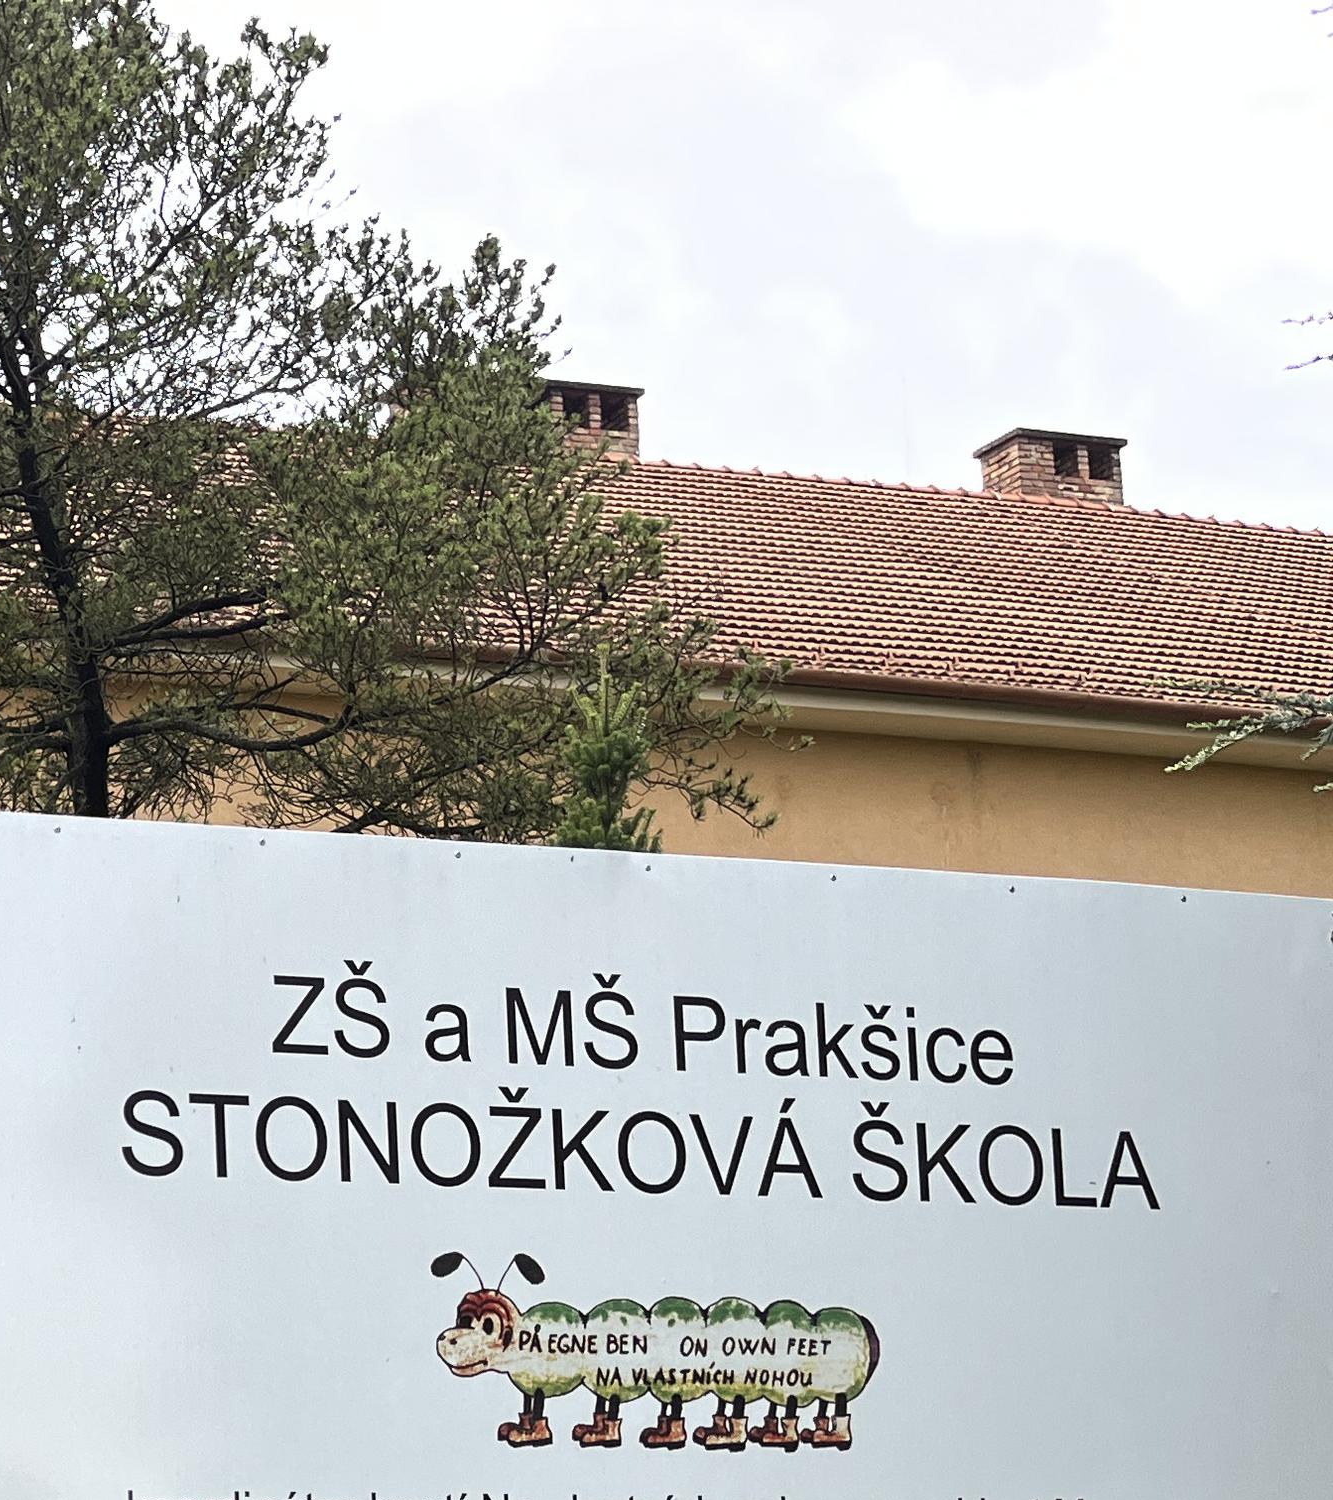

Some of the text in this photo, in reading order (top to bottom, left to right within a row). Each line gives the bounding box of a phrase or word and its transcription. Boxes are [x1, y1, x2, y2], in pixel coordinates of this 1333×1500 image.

[271, 958, 1016, 1087] ZŠ a MŠ Prakšice
[120, 1085, 1162, 1211] STONOŽKOVÁ ŠKOLA
[547, 1333, 598, 1355] EGNE
[606, 1333, 648, 1355] BEN
[679, 1335, 708, 1358] ON
[722, 1336, 776, 1357] OWN
[786, 1337, 832, 1357] FEET
[596, 1366, 623, 1387] NA
[743, 1367, 813, 1388] NOHOU
